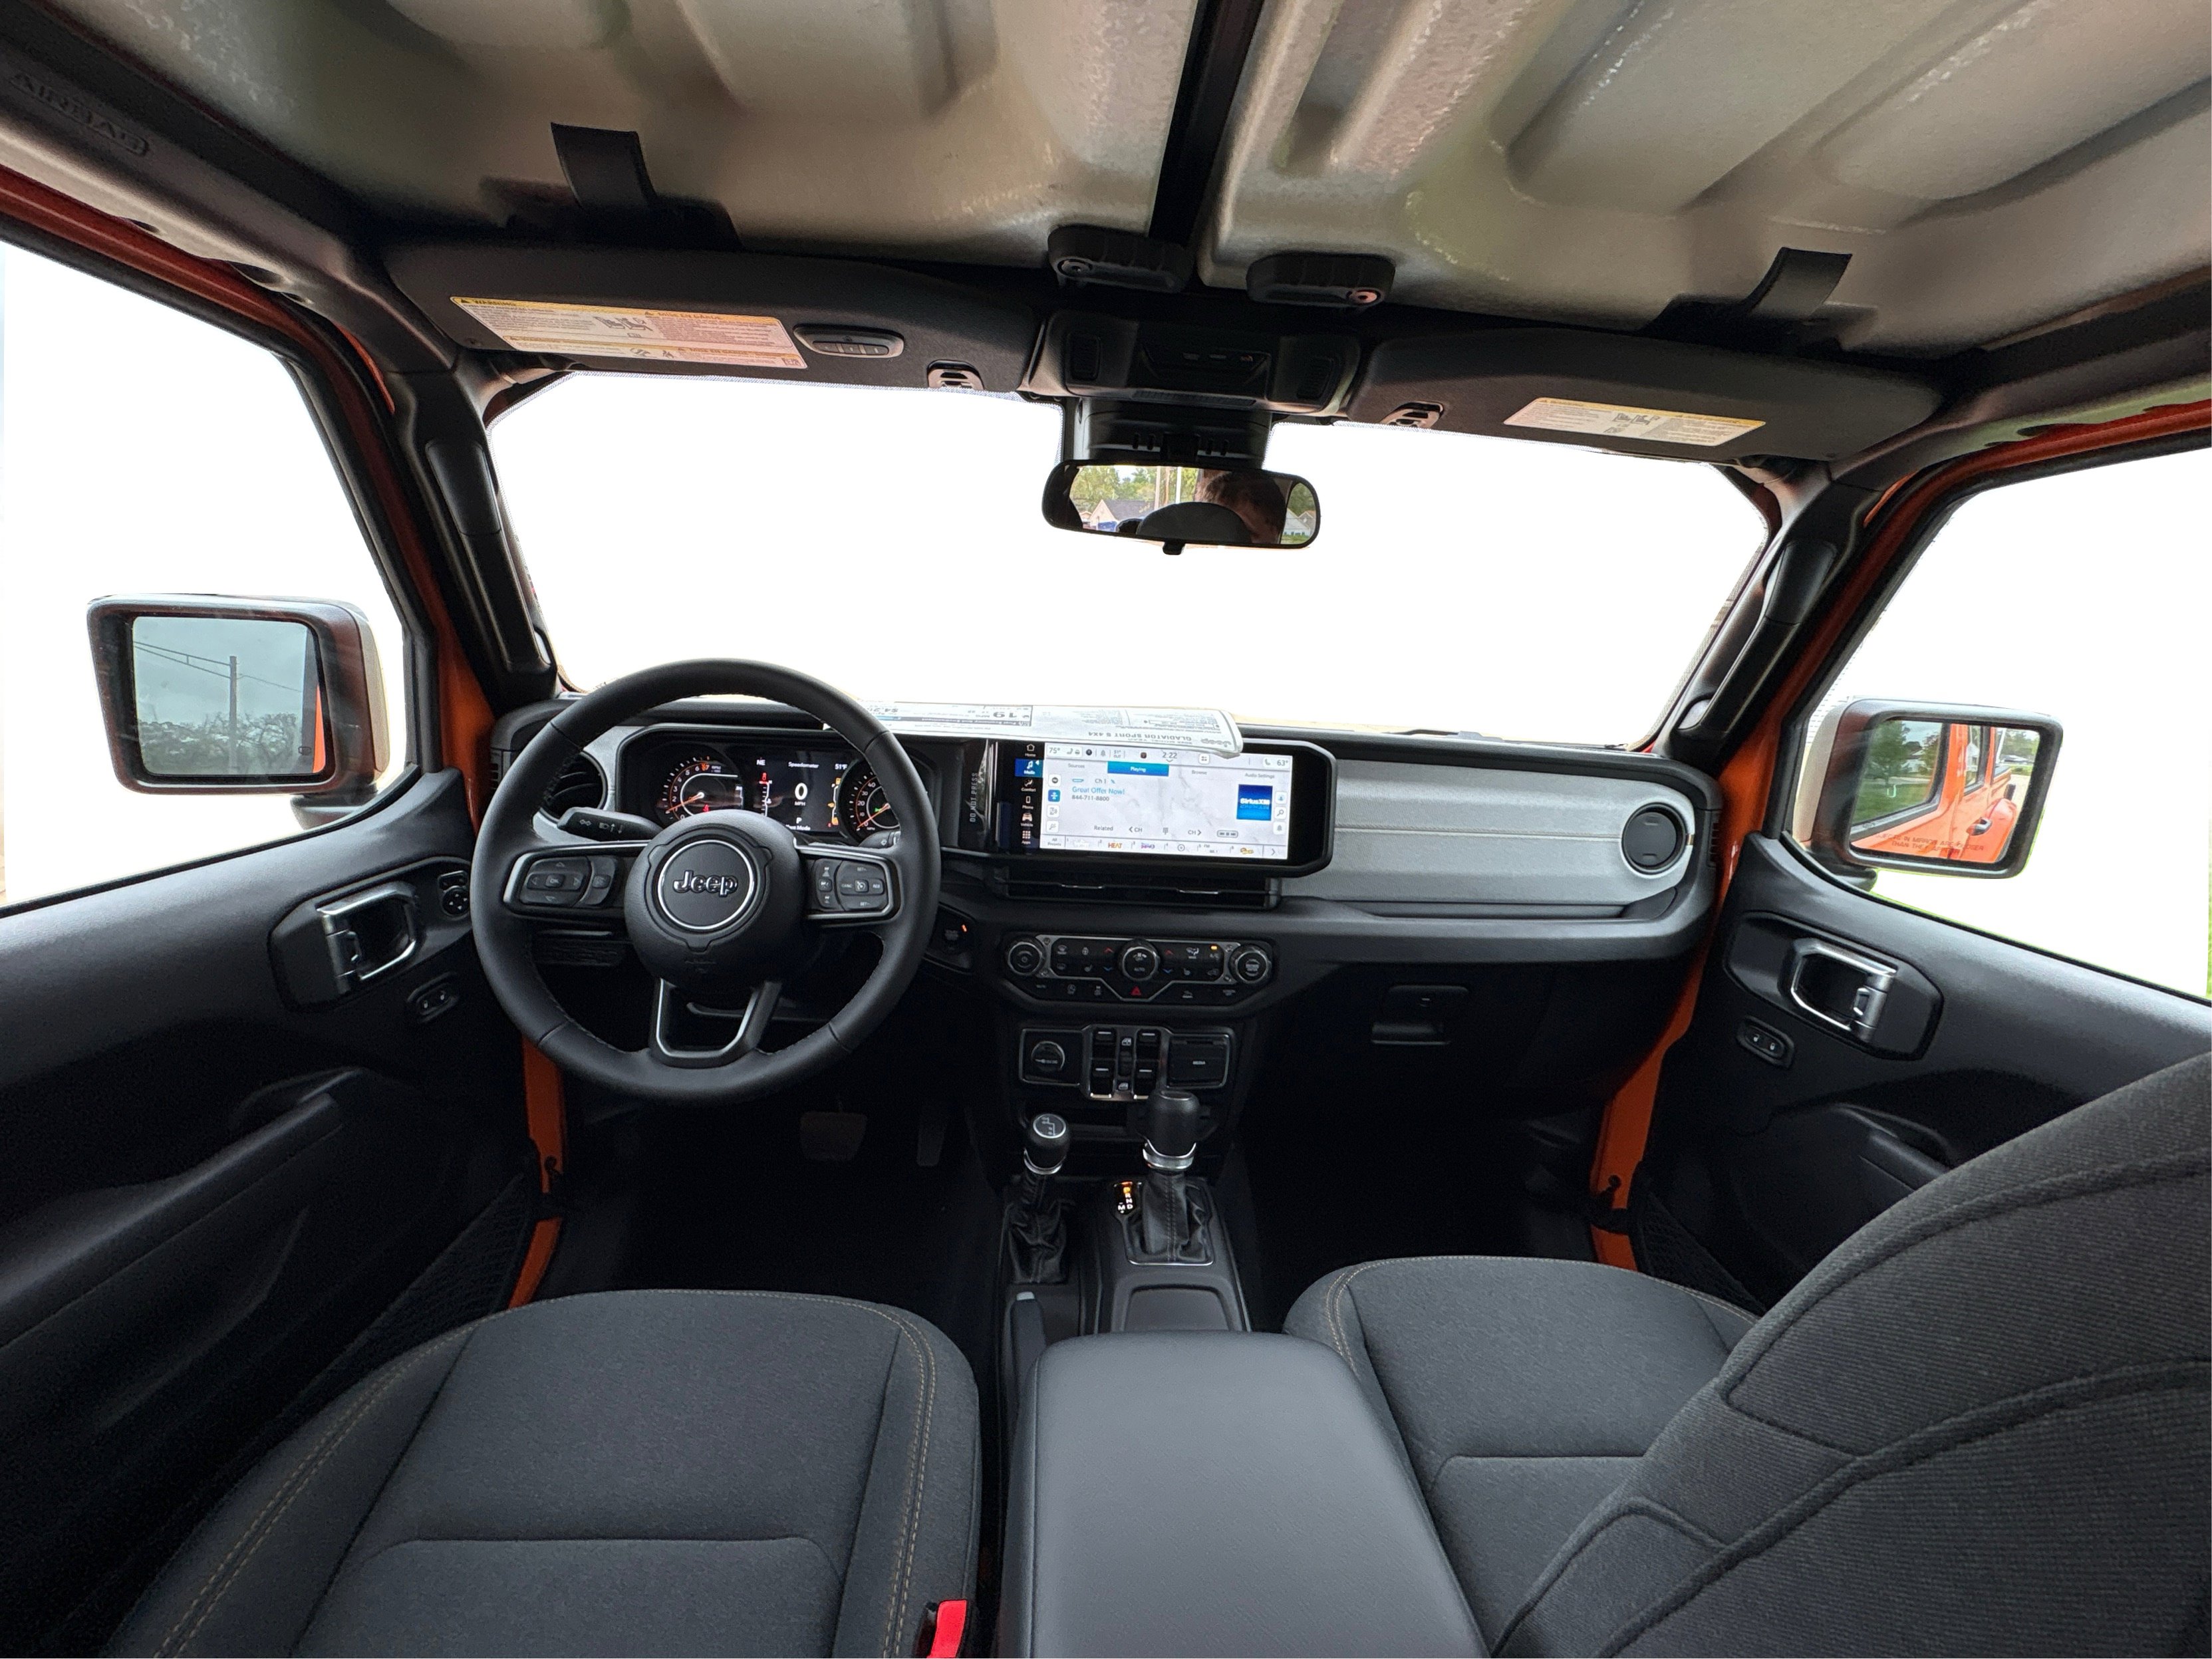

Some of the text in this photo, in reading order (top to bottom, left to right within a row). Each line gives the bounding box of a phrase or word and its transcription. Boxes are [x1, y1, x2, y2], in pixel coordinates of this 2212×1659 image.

[1201, 739, 1232, 747] Jeep
[794, 782, 808, 801] 0
[969, 813, 976, 823] DO
[672, 870, 739, 898] Jeep
